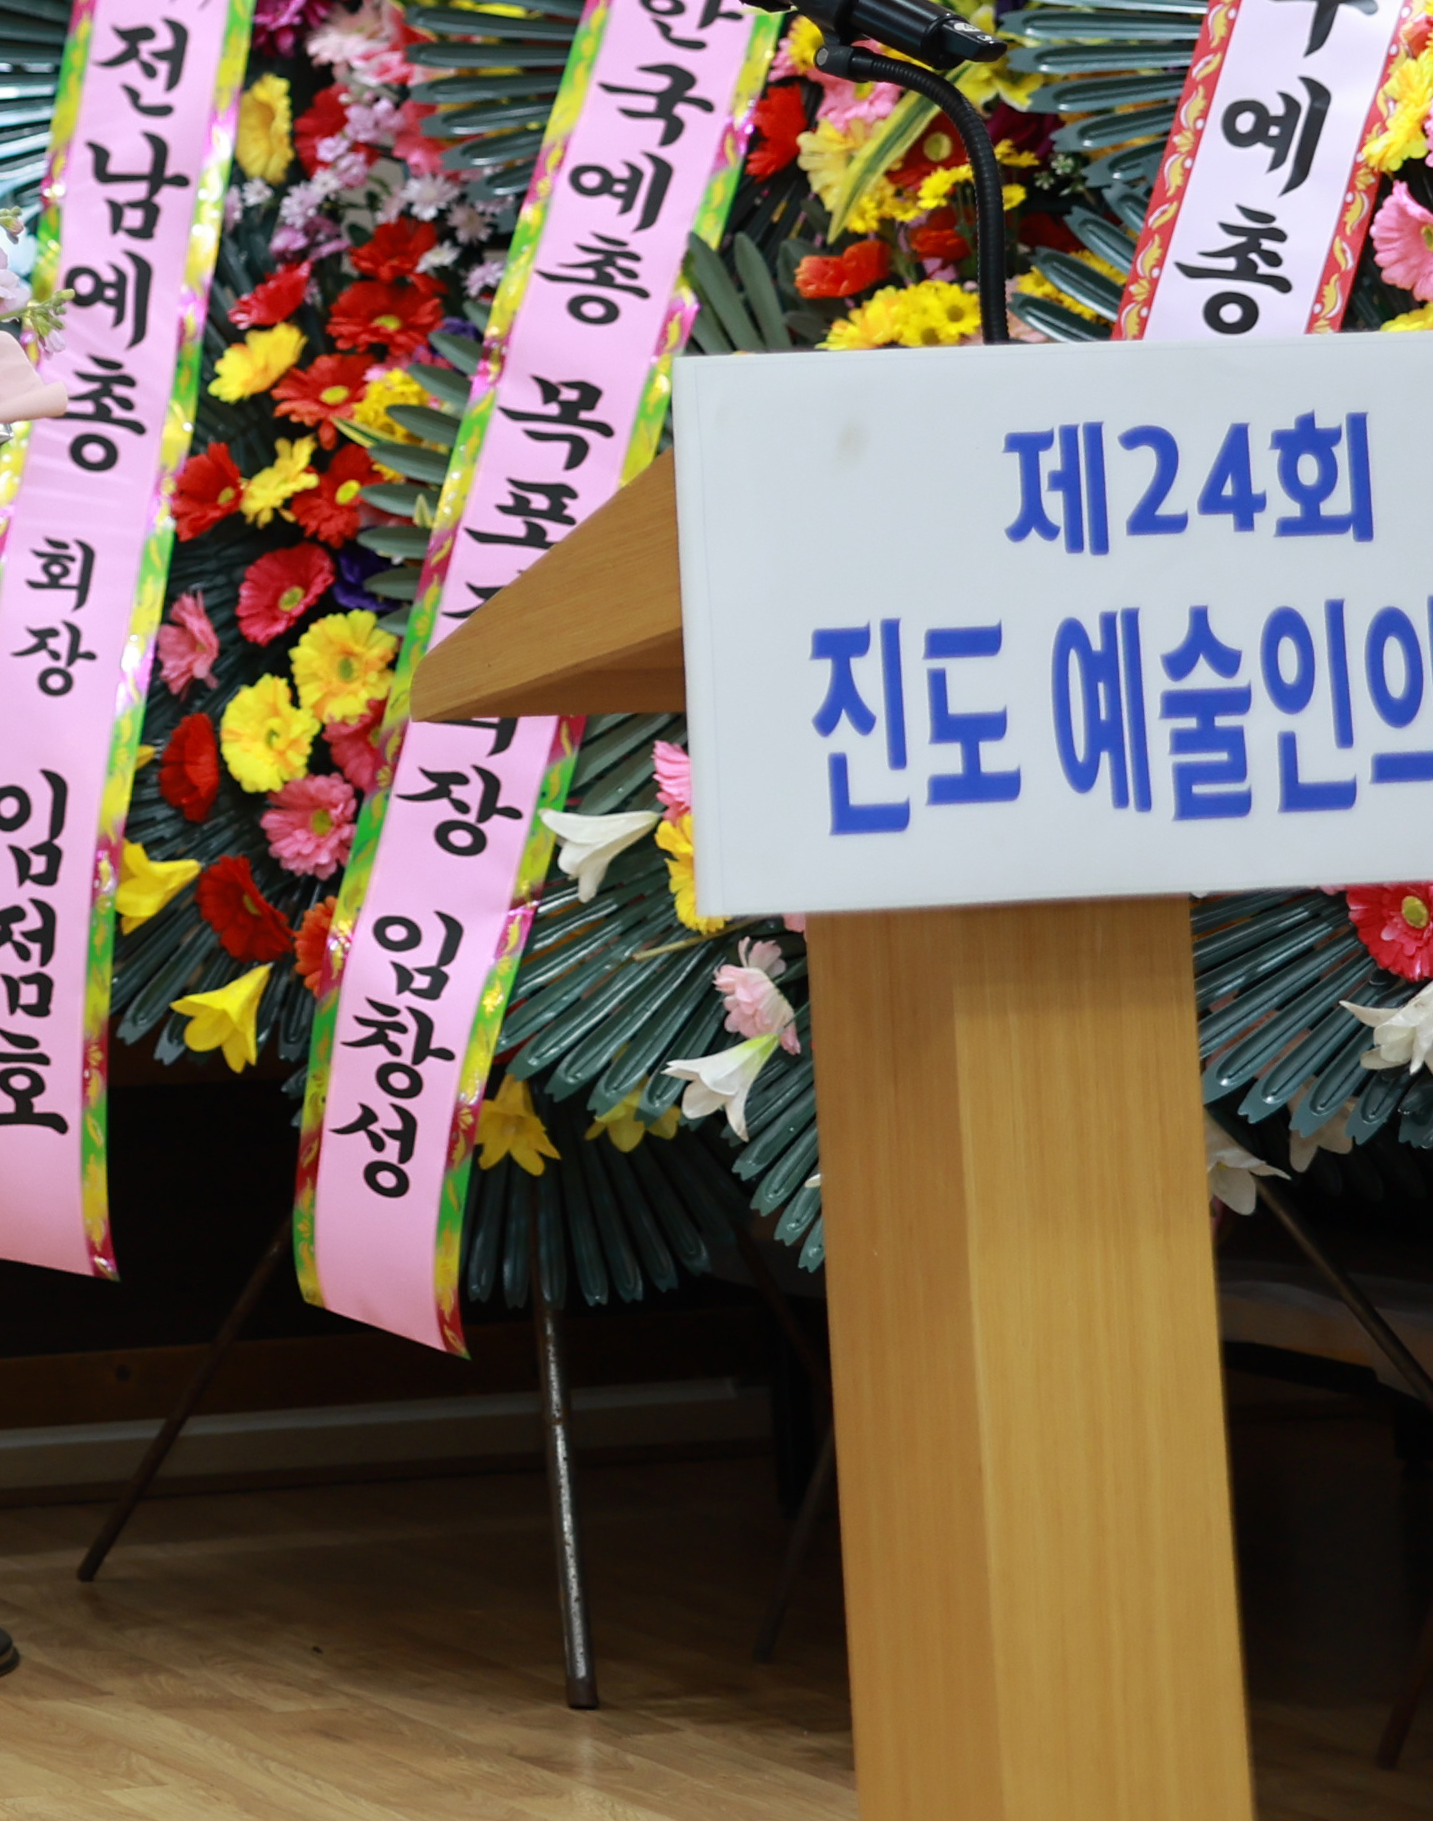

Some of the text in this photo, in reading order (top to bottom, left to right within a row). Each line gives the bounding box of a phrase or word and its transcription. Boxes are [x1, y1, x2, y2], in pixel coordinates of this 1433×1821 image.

[1001, 410, 1376, 556] 제24회
[13, 535, 97, 700] 회장
[810, 617, 1022, 836] 진도
[333, 911, 464, 1200] 임창성
